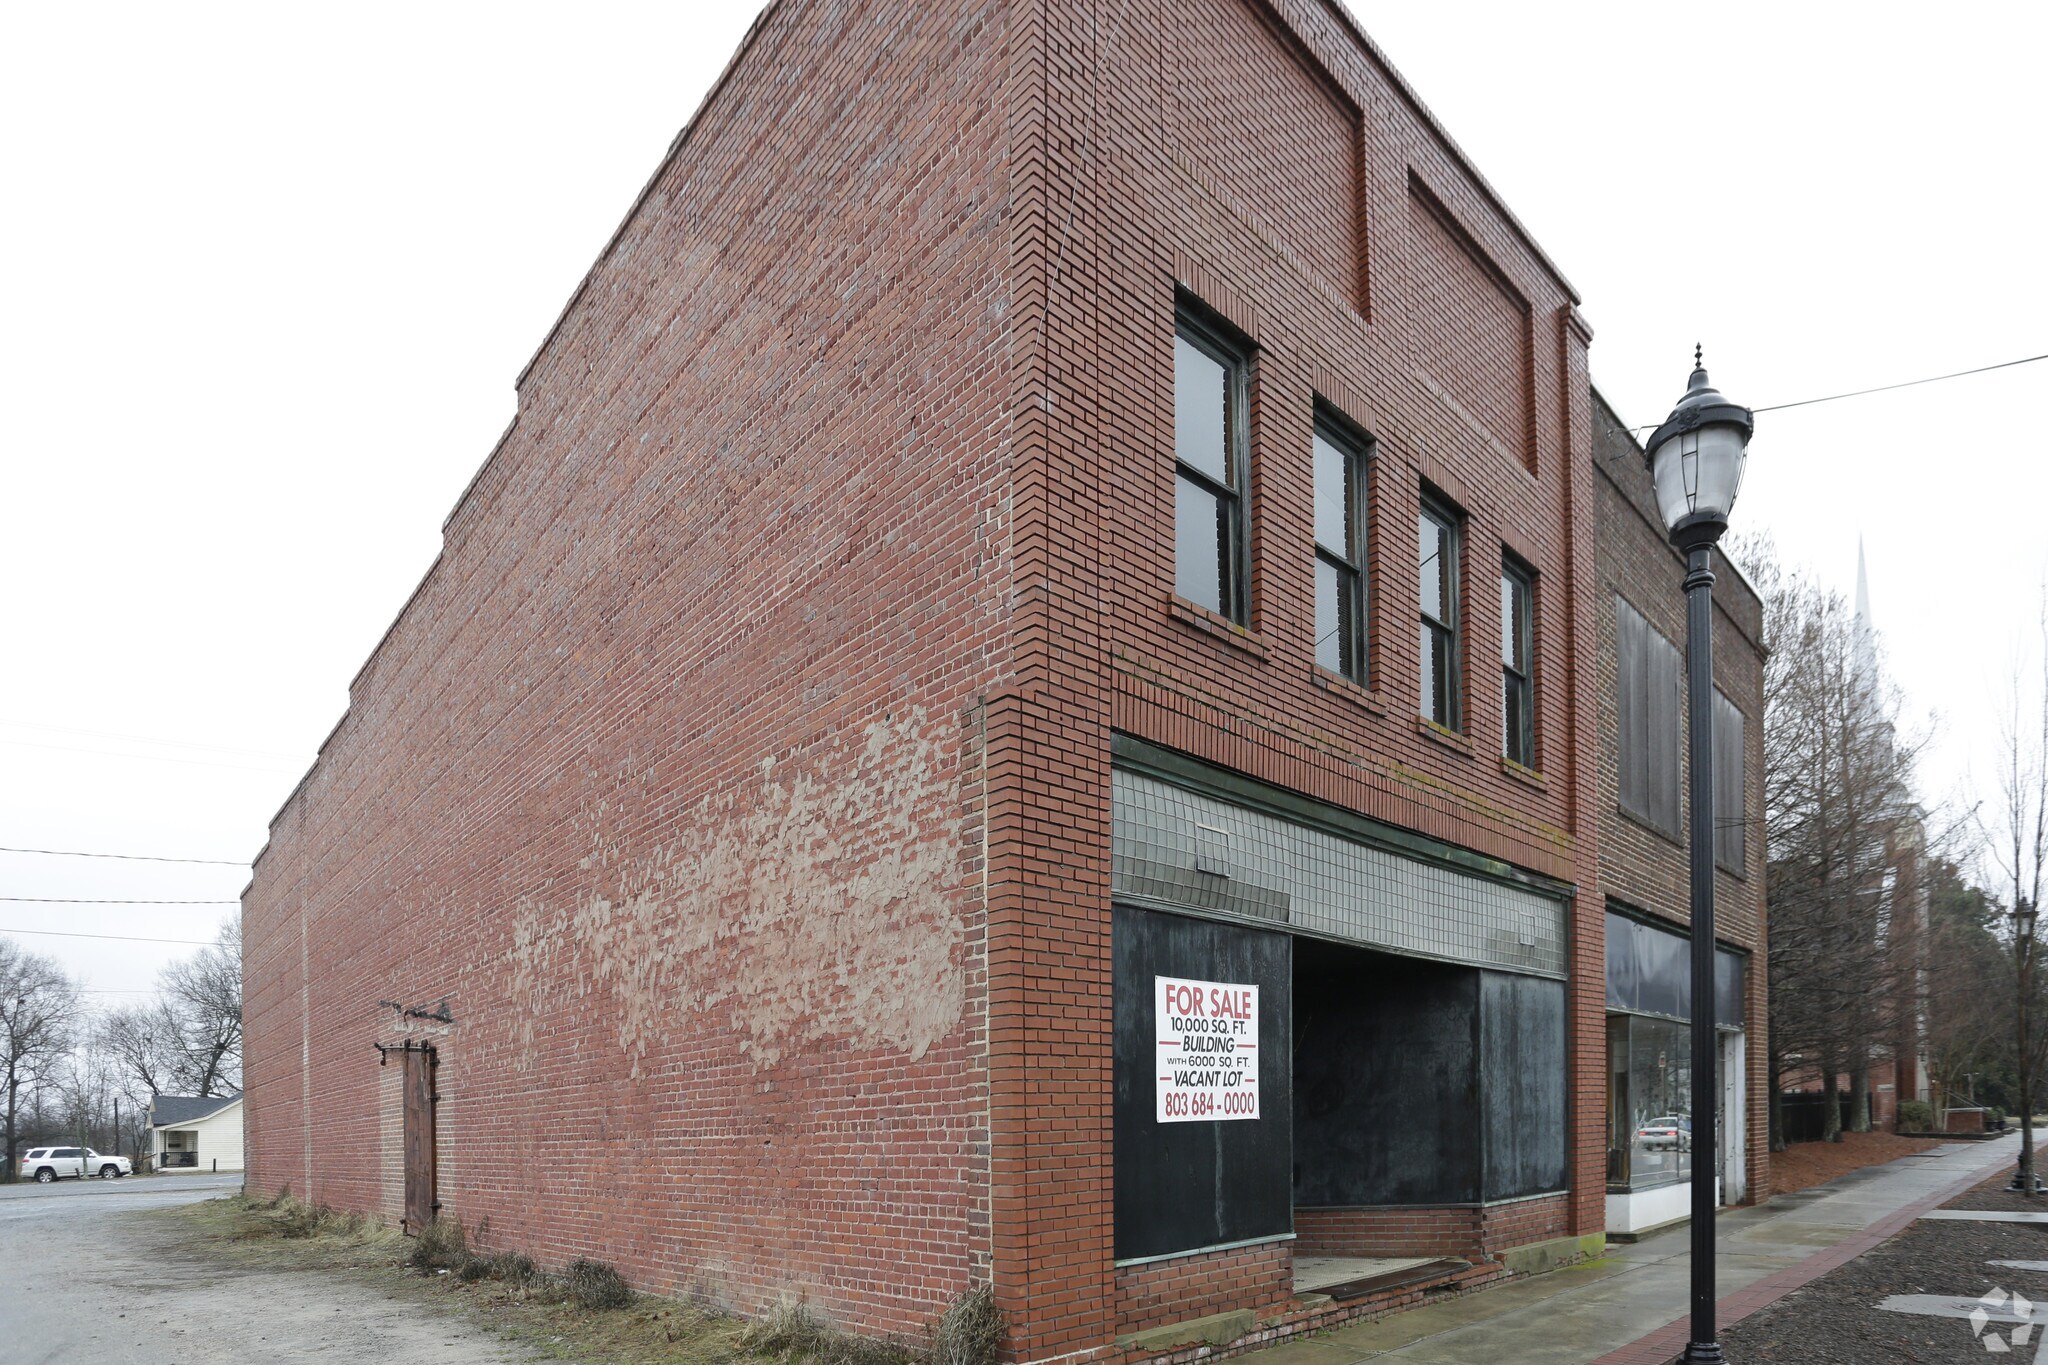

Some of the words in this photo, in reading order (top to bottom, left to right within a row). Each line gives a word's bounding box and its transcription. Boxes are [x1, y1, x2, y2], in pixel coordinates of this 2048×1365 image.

[1166, 984, 1205, 1016] FOR
[1210, 988, 1251, 1019] SALE
[1171, 1017, 1209, 1034] 10,000
[1211, 1019, 1230, 1034] SQ.
[1232, 1021, 1247, 1035] FT.
[1182, 1036, 1234, 1053] BUILDING
[1167, 1057, 1187, 1066] WITH
[1188, 1056, 1216, 1067] 6000
[1218, 1057, 1234, 1068] SQ.
[1236, 1057, 1251, 1068] FT.
[1174, 1071, 1221, 1087] VACANT
[1222, 1071, 1243, 1087] LOT
[1165, 1092, 1189, 1117] 803
